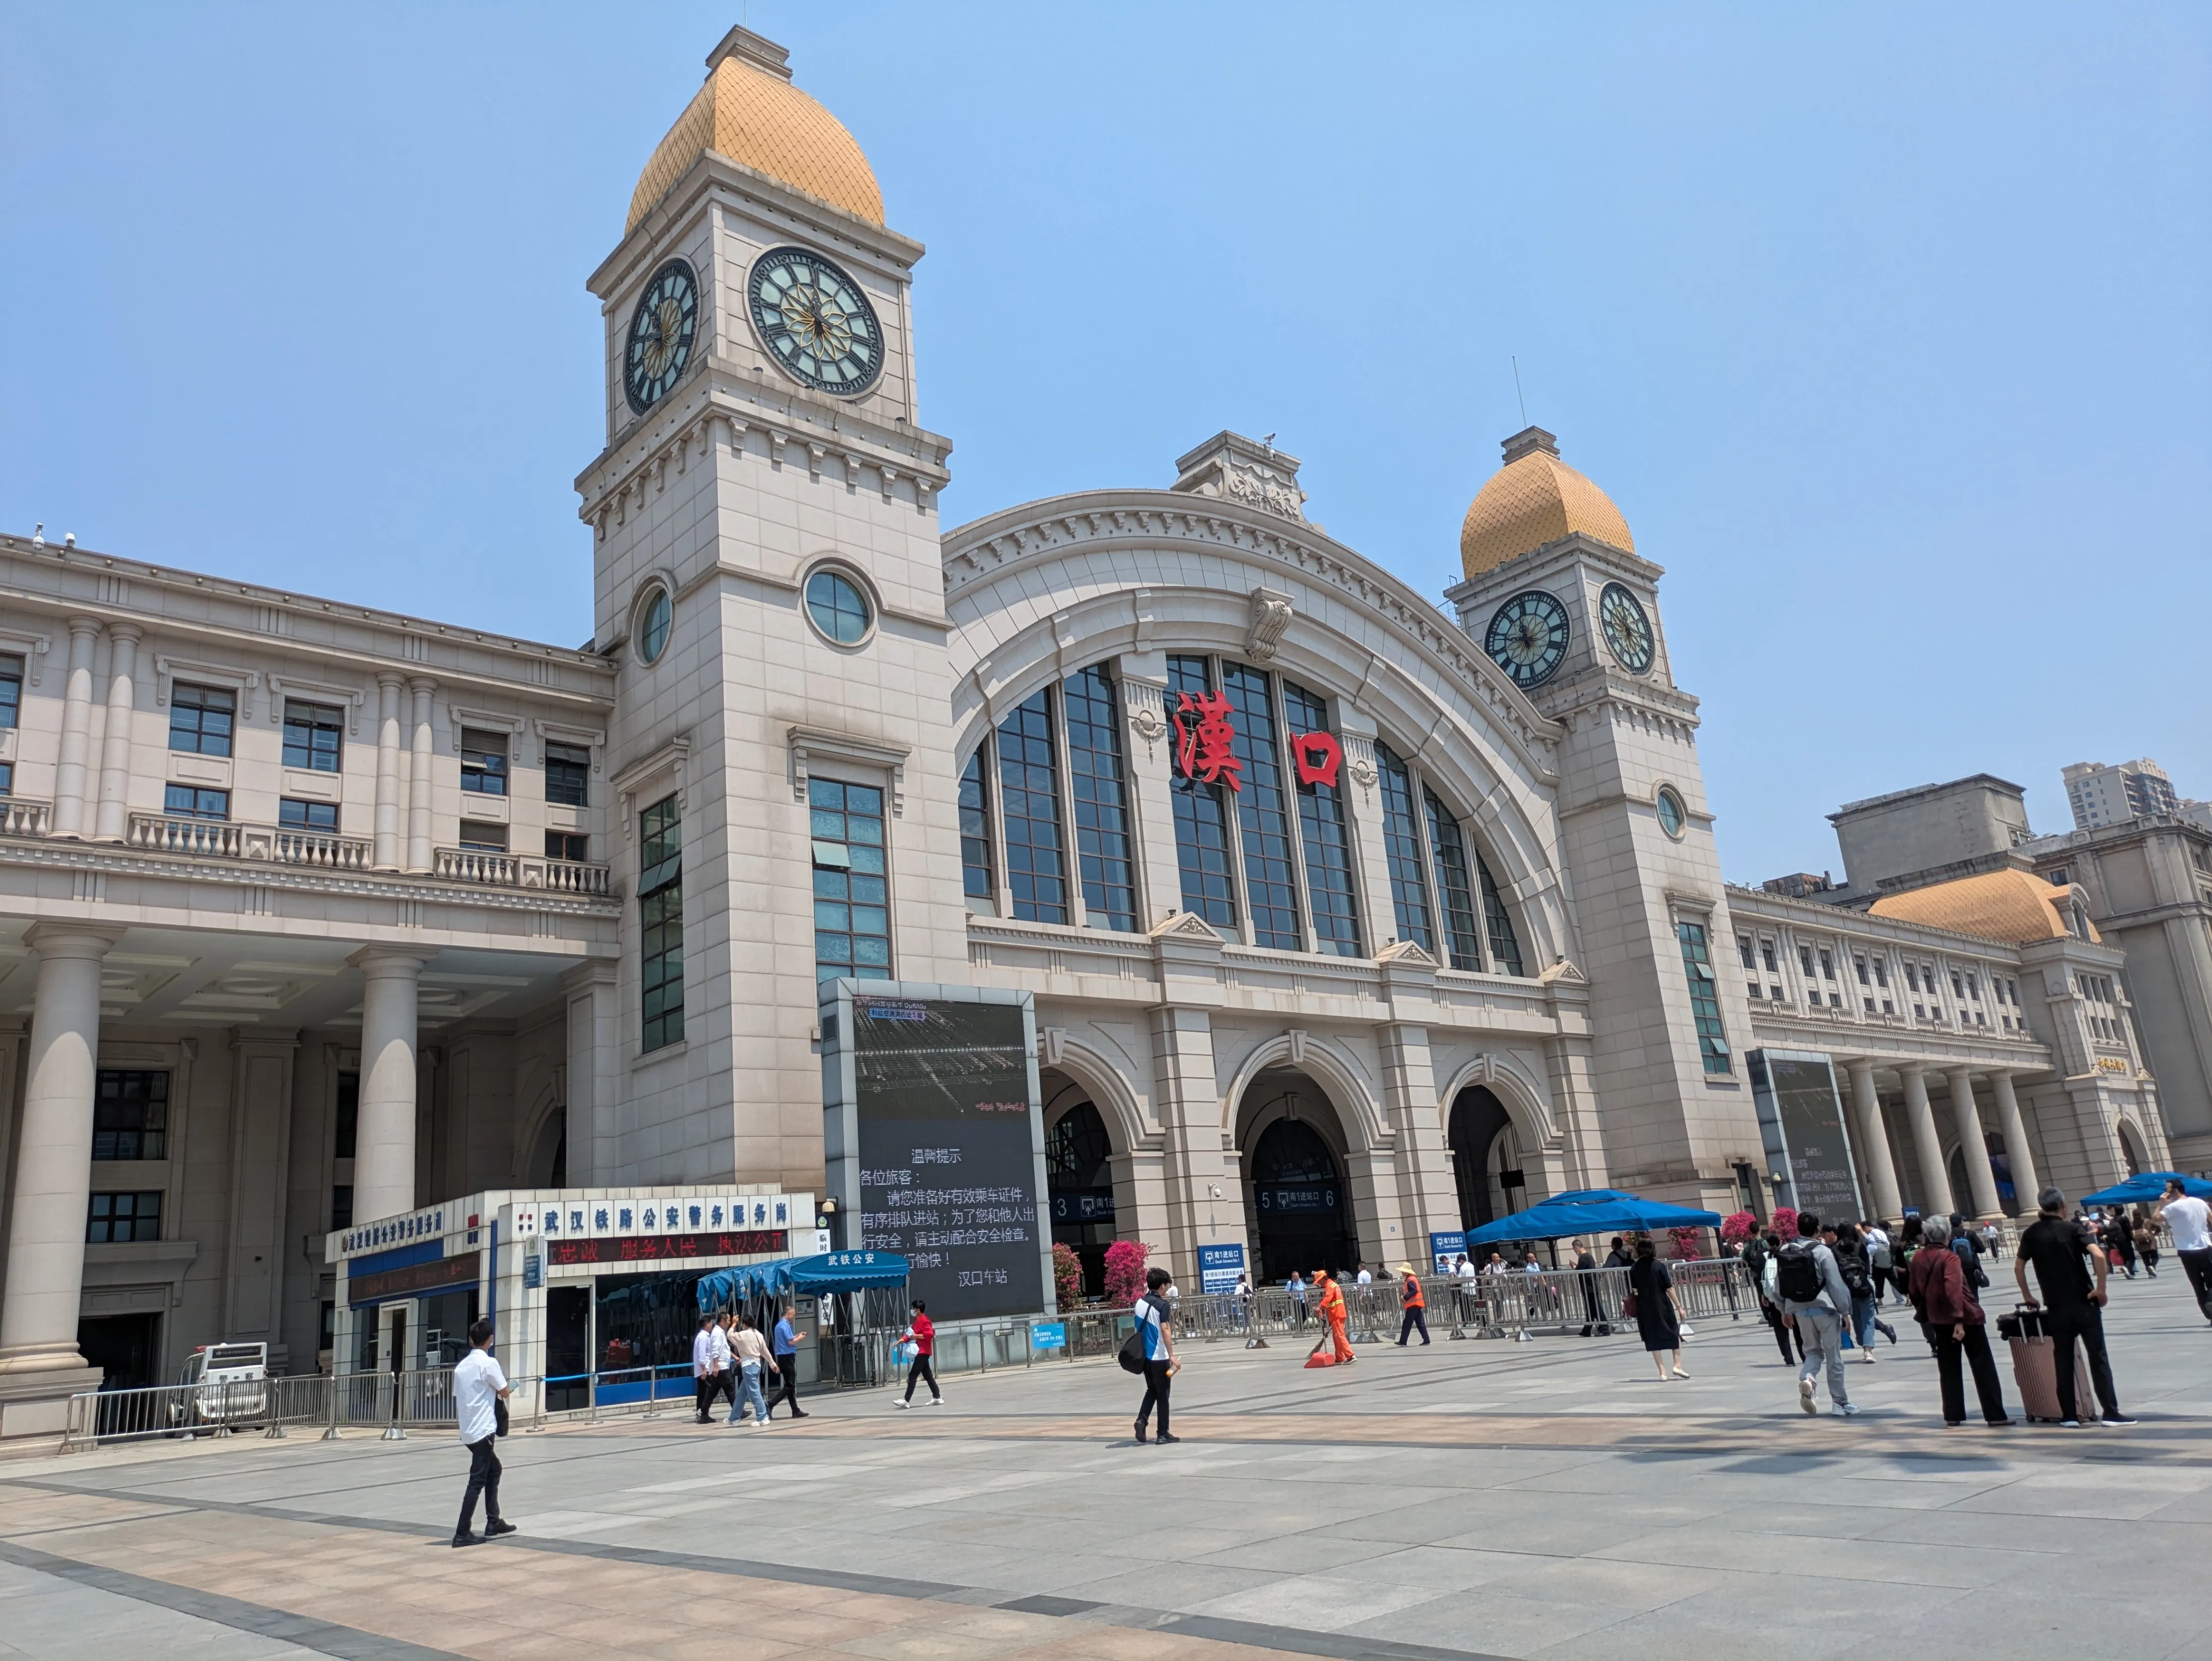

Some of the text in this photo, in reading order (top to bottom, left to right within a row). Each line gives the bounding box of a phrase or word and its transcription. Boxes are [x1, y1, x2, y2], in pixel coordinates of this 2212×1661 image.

[1173, 690, 1342, 793] 漢口
[911, 1148, 962, 1164] 温馨提示
[1262, 1192, 1270, 1208] 5
[1290, 1191, 1319, 1201] 南1进站口
[1326, 1190, 1334, 1206] 6
[1057, 1198, 1067, 1216] 3
[545, 1202, 787, 1231] 武汉铁路公安警务服务岗
[553, 1240, 598, 1263] 忠诚
[620, 1237, 697, 1260] 服务人民
[819, 1234, 827, 1252] 临时
[827, 1253, 875, 1266] 武铁公安
[1214, 1250, 1238, 1259] 南1进站口
[958, 1268, 1007, 1287] 汉口车站
